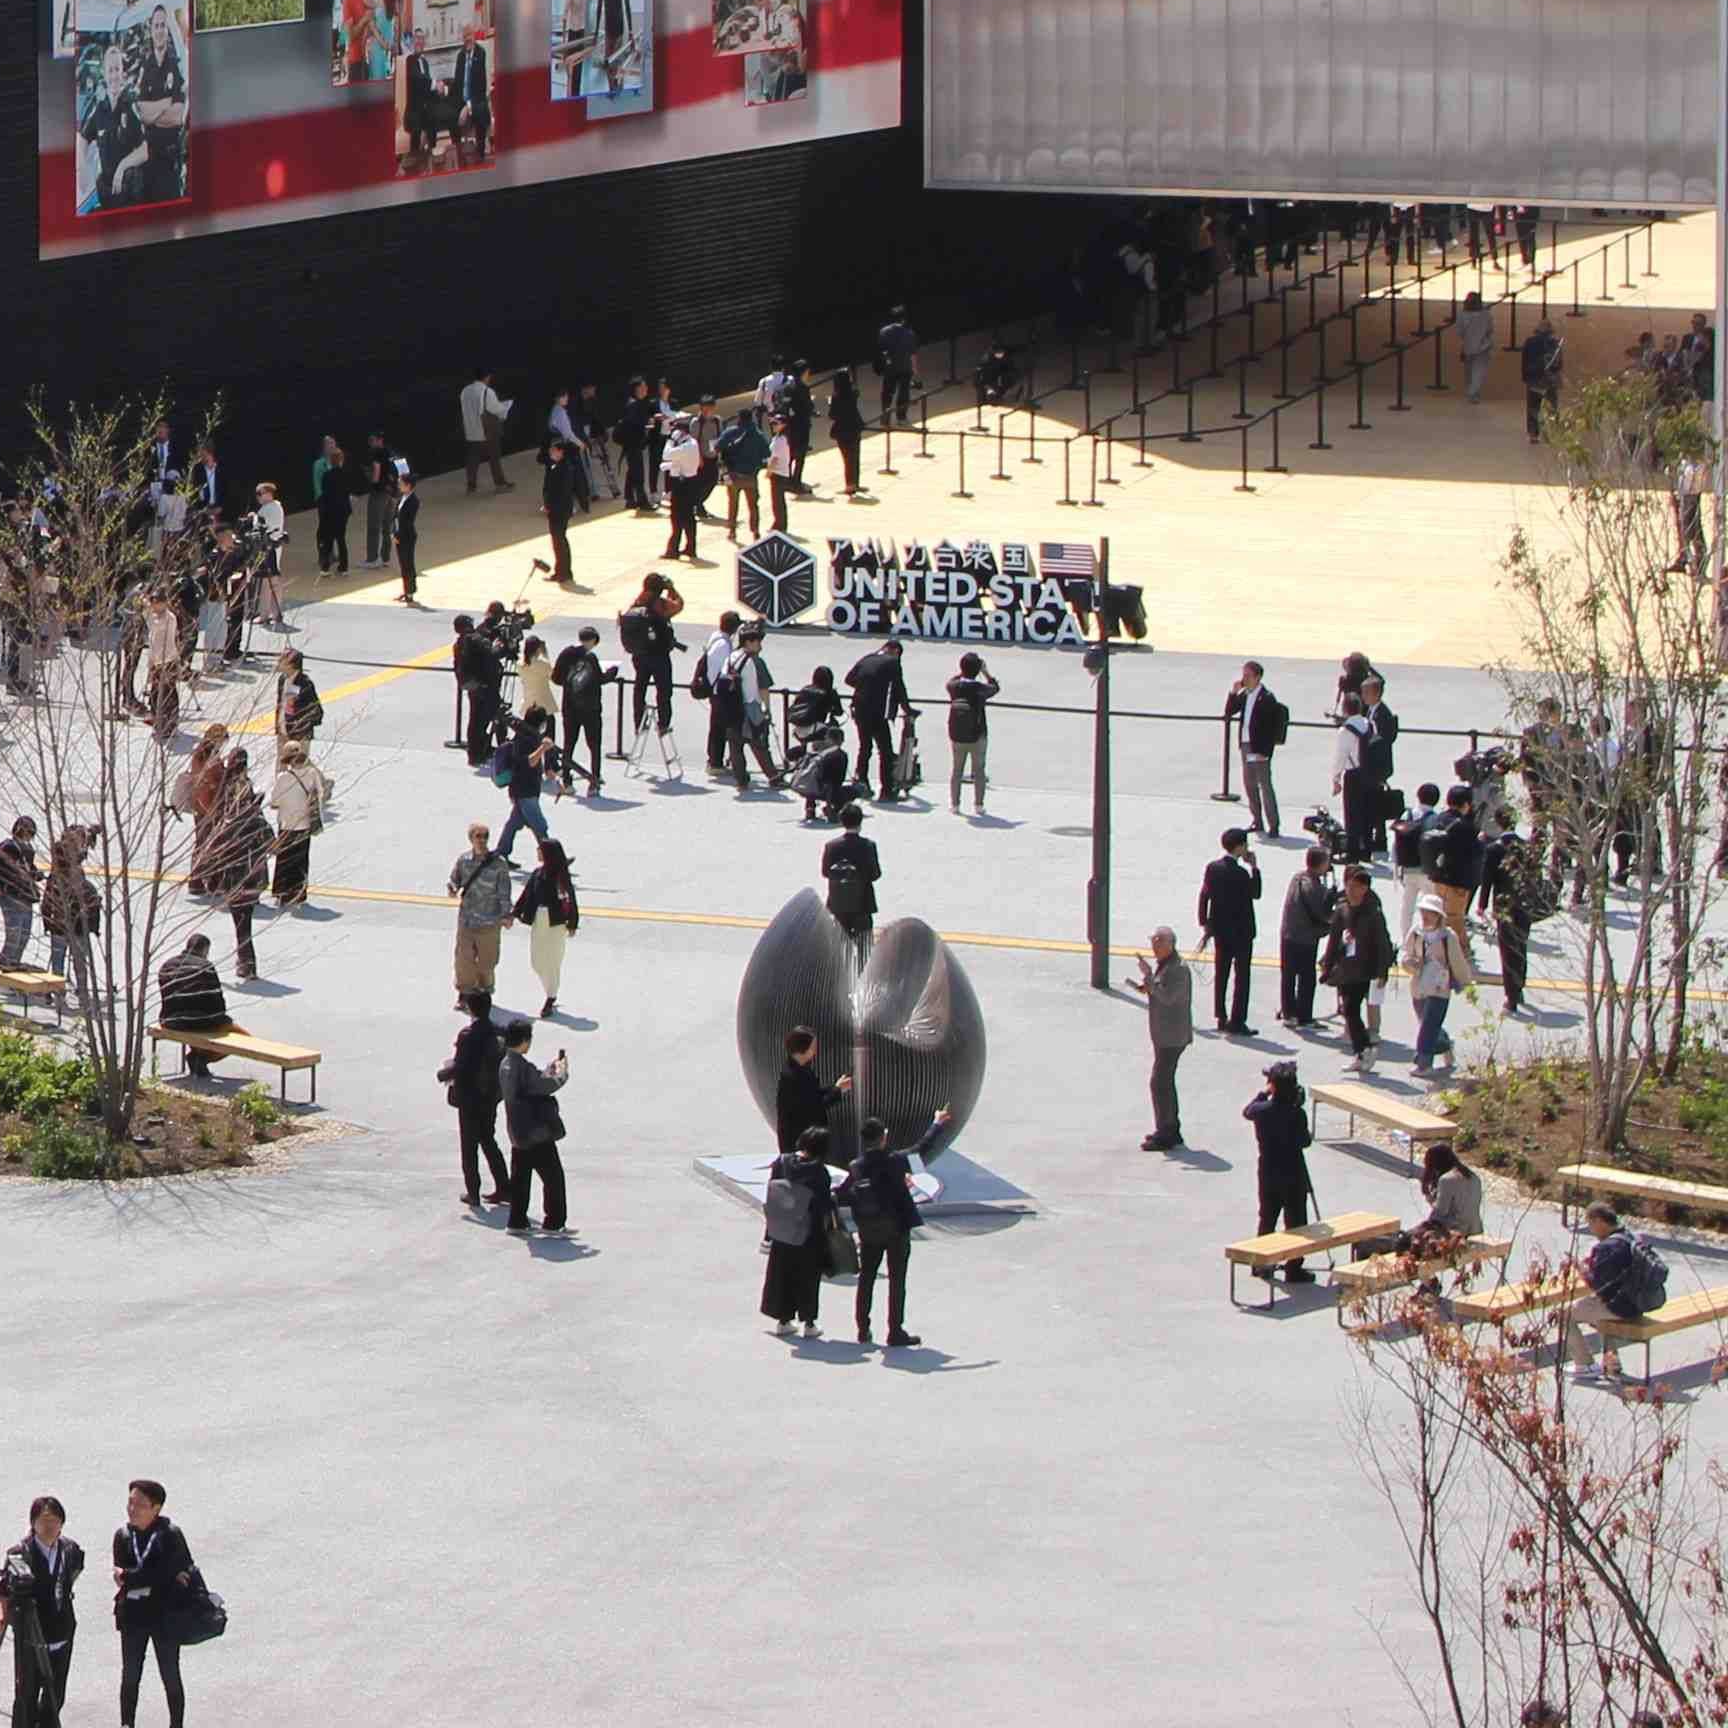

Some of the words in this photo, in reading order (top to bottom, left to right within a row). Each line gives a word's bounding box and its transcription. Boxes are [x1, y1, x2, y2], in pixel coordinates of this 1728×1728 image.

[830, 538, 1029, 573] アメリカ合衆国
[831, 566, 978, 605] UNITED
[988, 574, 1100, 612] STA
[826, 599, 881, 633] OF
[890, 604, 1086, 646] AMERICA
